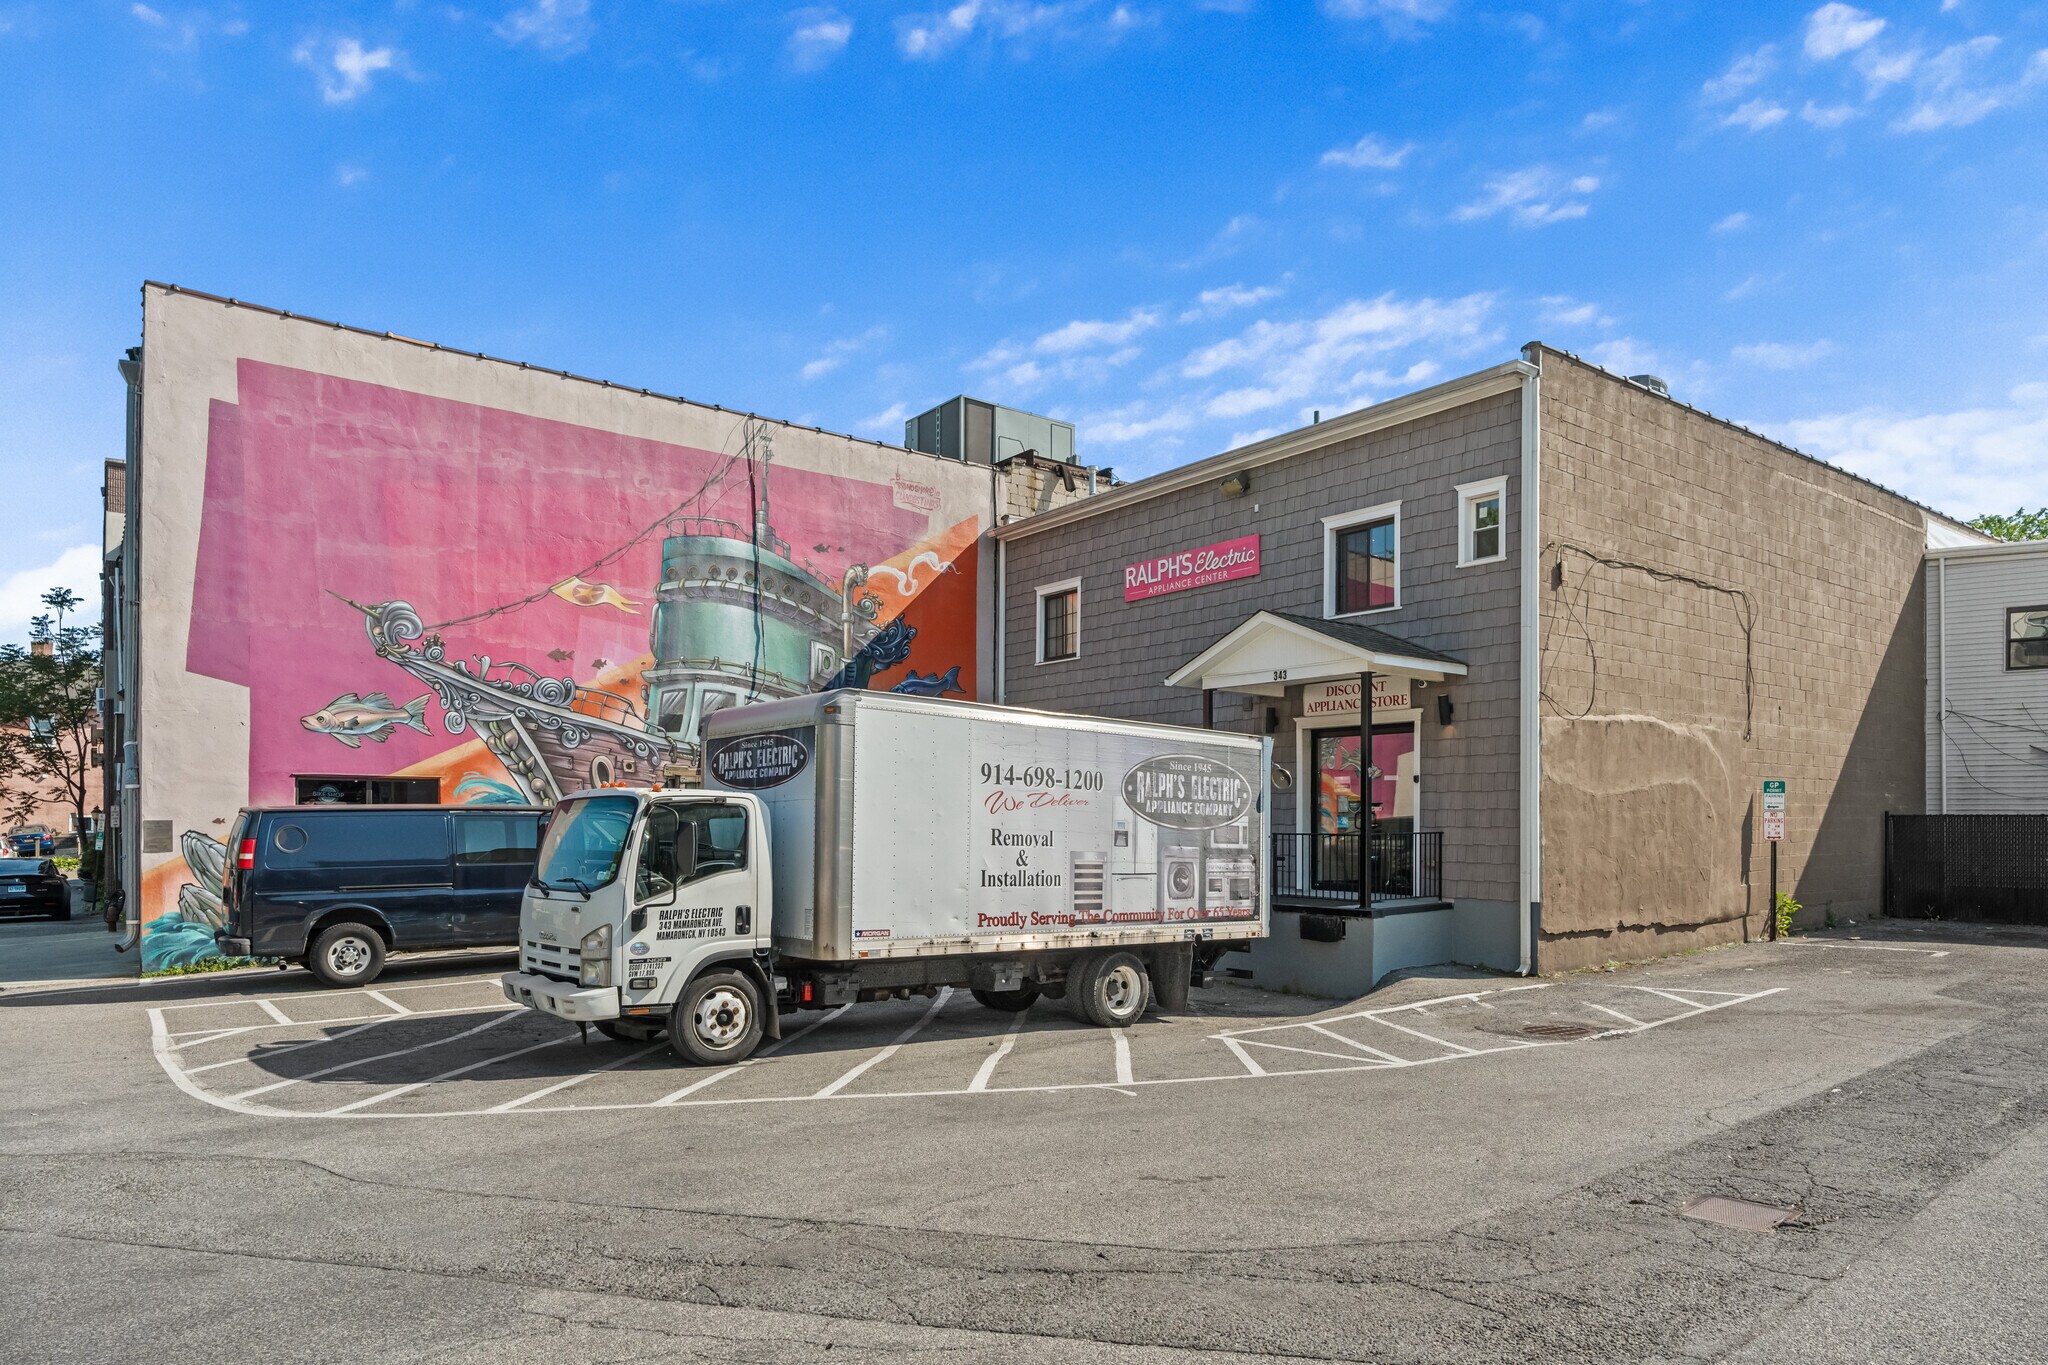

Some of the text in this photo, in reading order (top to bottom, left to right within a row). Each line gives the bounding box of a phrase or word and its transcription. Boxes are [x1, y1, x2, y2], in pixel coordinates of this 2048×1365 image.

[1126, 547, 1256, 589] RALPH'S Electric
[1148, 570, 1229, 595] APPLIANCE CENTER
[1273, 670, 1288, 681] 343
[1326, 681, 1387, 697] DISCONT
[1306, 693, 1409, 713] APPLIANC STORE
[741, 738, 774, 749] Since 1945
[718, 744, 799, 775] RALPH'S ELECTRIC
[1169, 761, 1212, 773] Since 1945
[724, 765, 791, 780] APPLIANCE COMPANY
[980, 762, 1104, 791] 914-698-1200
[1136, 771, 1241, 809] RALPH'S ELECTRIC
[984, 790, 1090, 815] We Deliver
[1145, 799, 1233, 817] APPLIANCE COMPANY
[990, 828, 1054, 847] Removal
[1015, 849, 1029, 867] &
[980, 869, 1062, 888] Installation
[659, 907, 724, 921] RALPH'S ELECTRIC
[977, 904, 1251, 929] Proudly Serving The Community For Over 65 Years
[659, 918, 723, 930] 343 MAMARONECK AVE.
[656, 928, 727, 940] MAMARONECK, NY 10543
